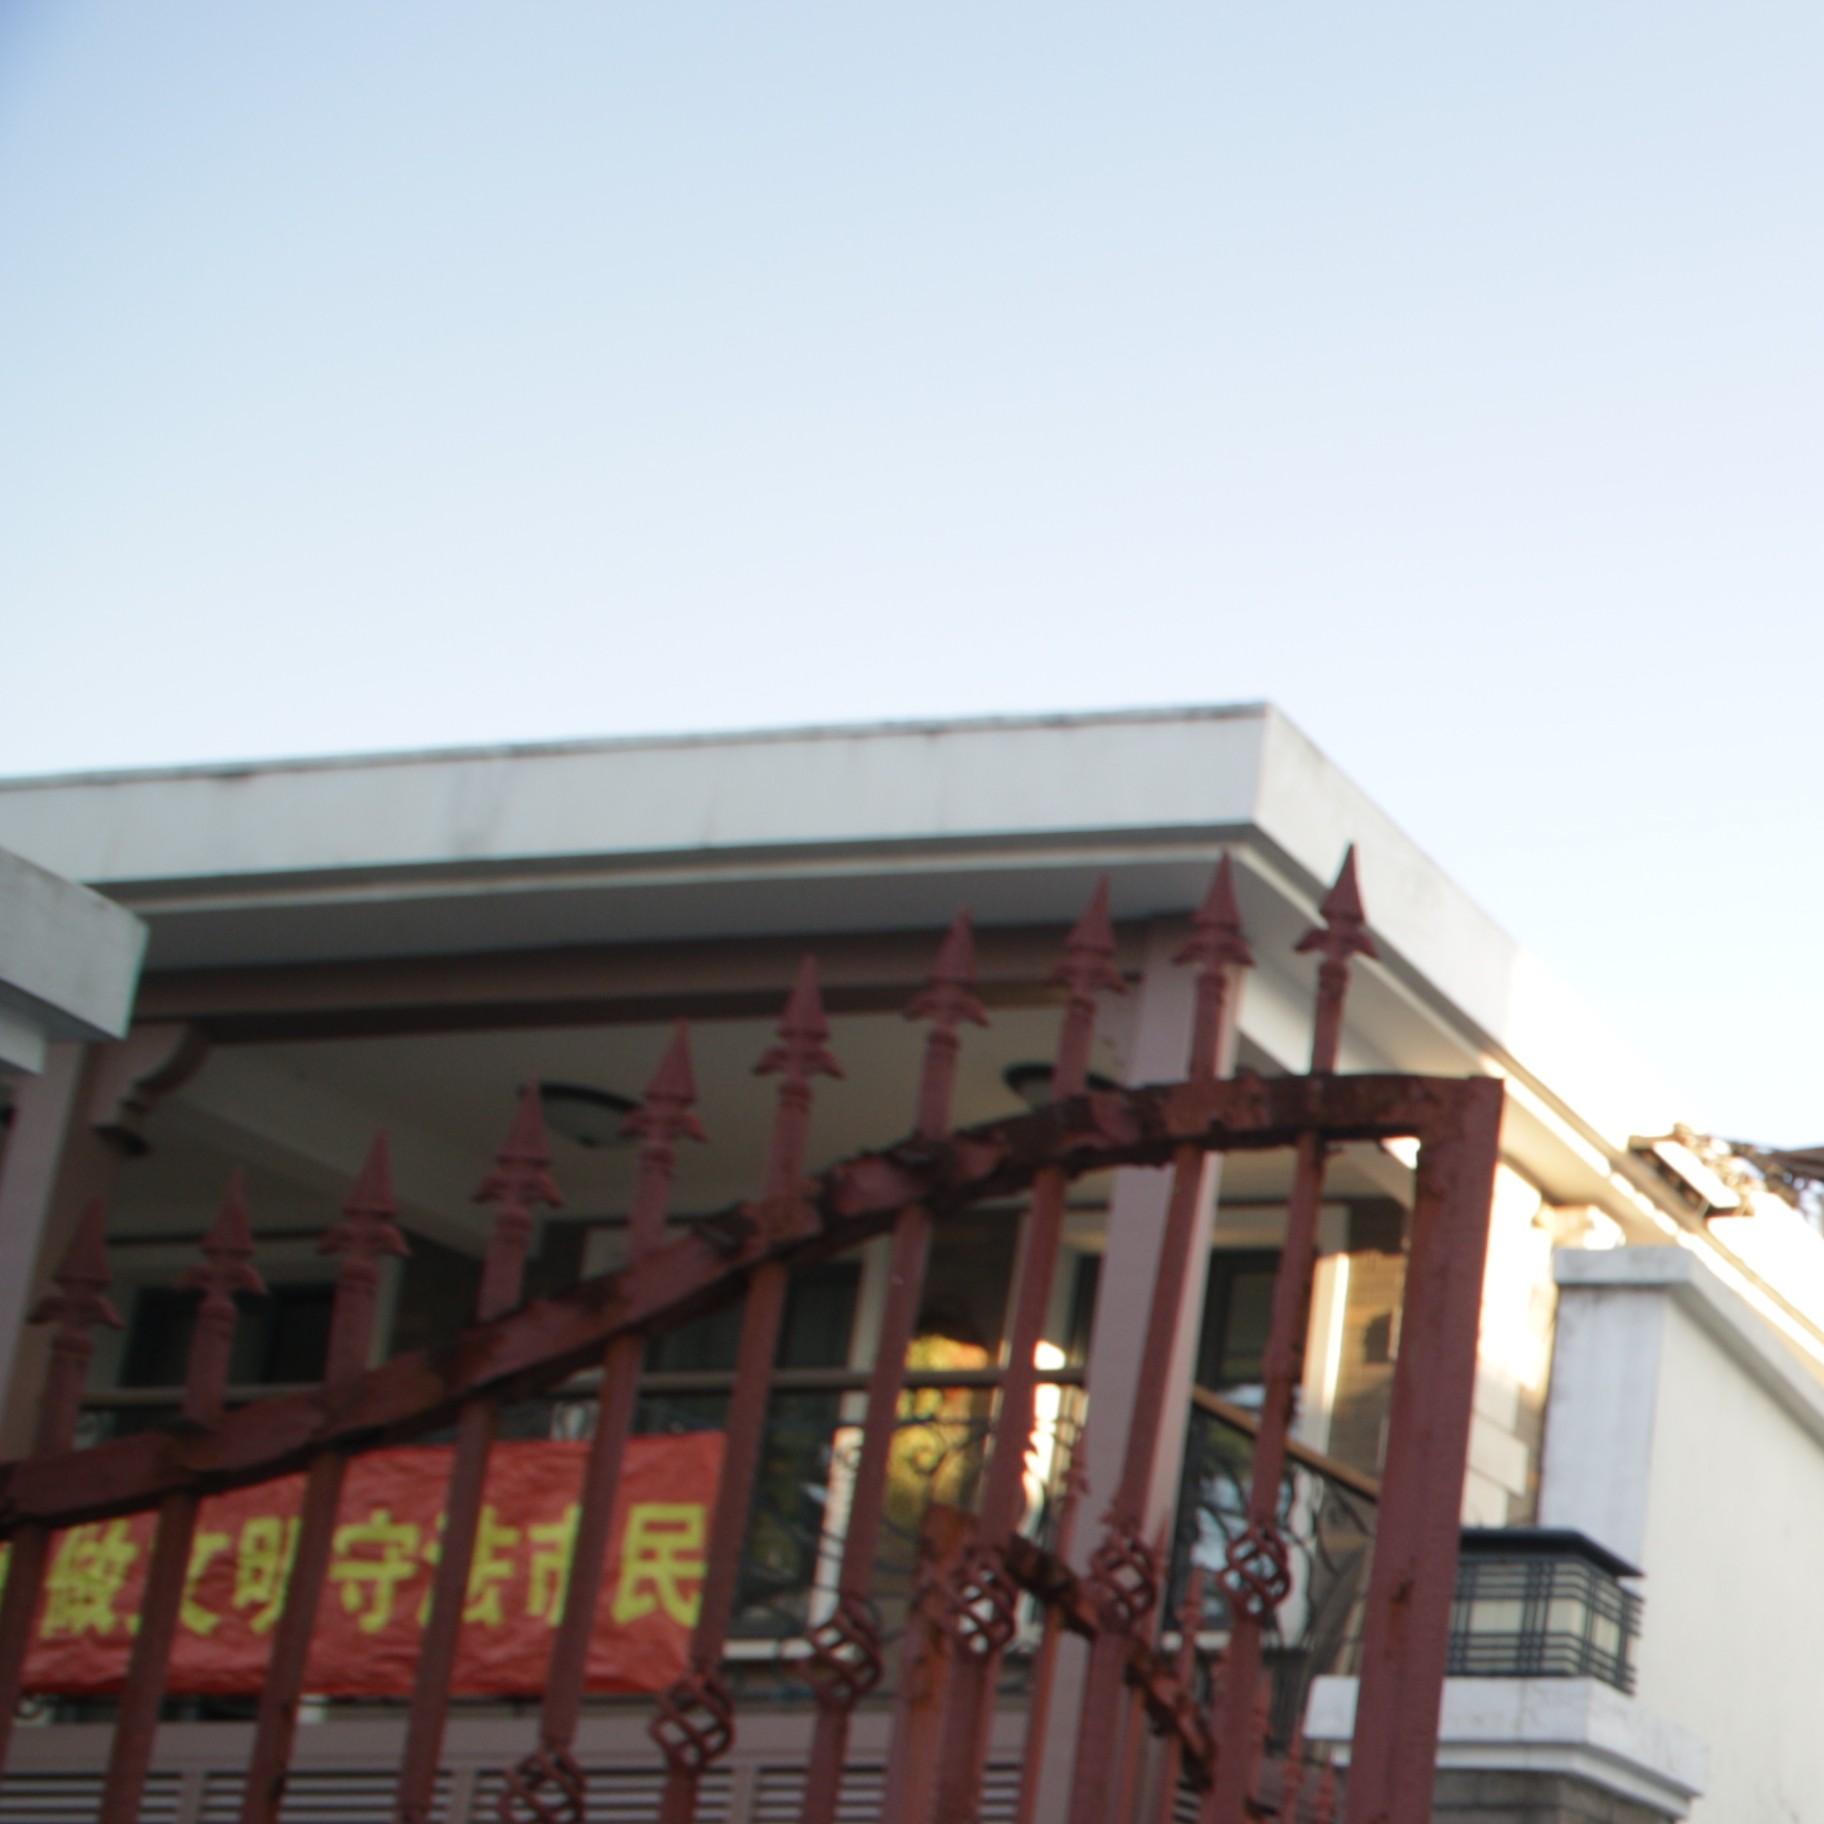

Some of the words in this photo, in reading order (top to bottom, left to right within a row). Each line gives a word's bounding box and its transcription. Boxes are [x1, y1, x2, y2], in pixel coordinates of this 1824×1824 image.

[0, 1504, 708, 1638] 做文明守法市民
